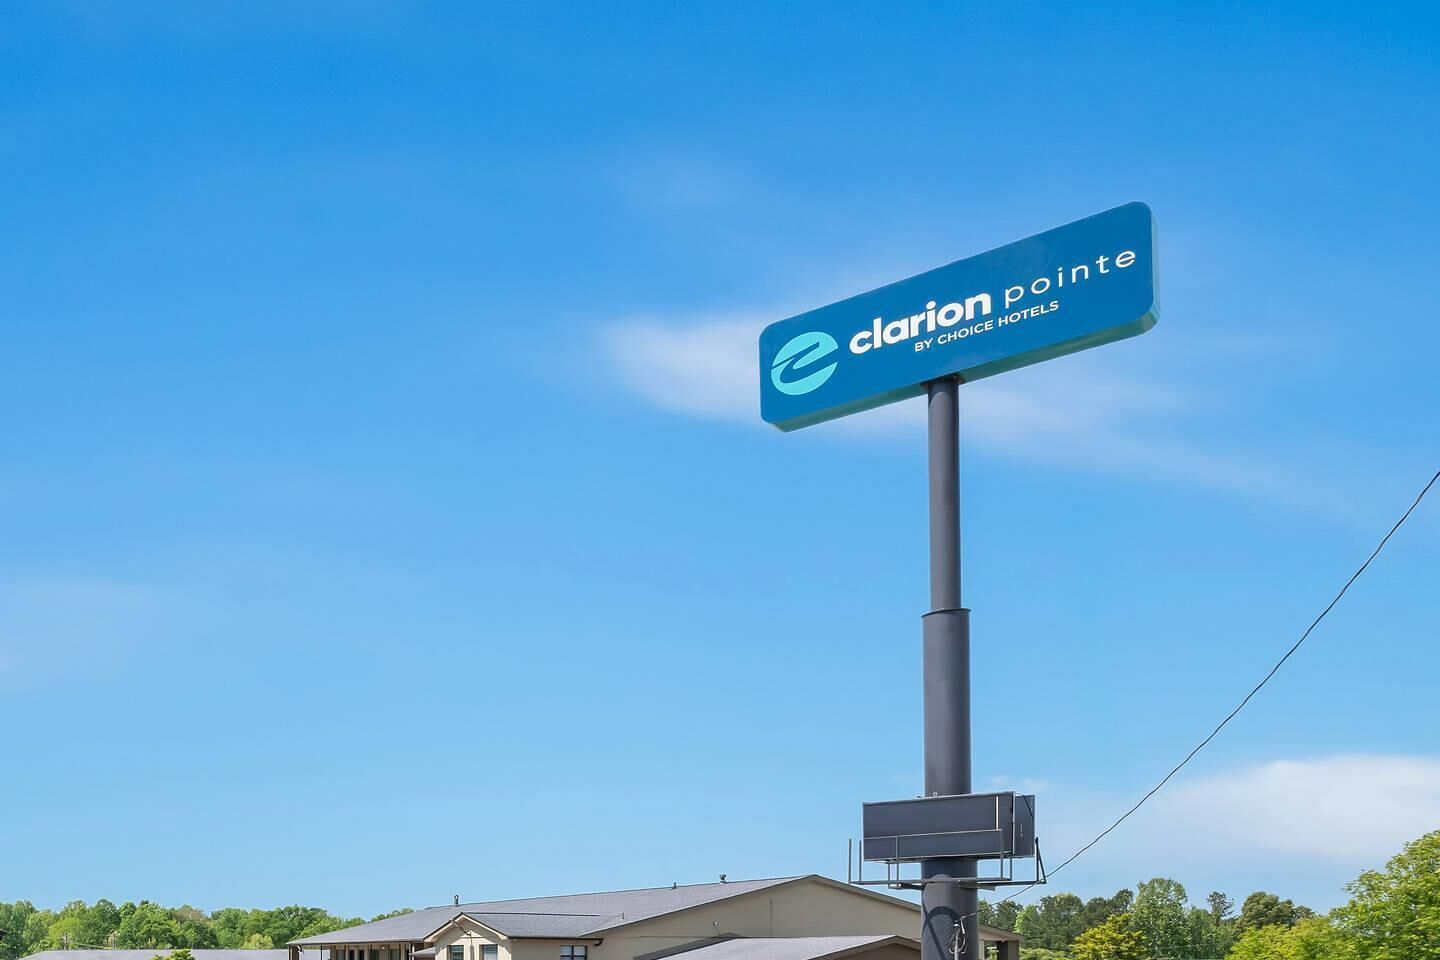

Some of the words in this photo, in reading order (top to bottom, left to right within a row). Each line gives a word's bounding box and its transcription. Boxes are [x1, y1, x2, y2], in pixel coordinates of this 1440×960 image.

[849, 291, 992, 355] clarion
[1004, 249, 1136, 309] pointe
[914, 336, 934, 352] BY
[937, 319, 994, 345] CHOICE
[998, 300, 1059, 328] HOTELS
